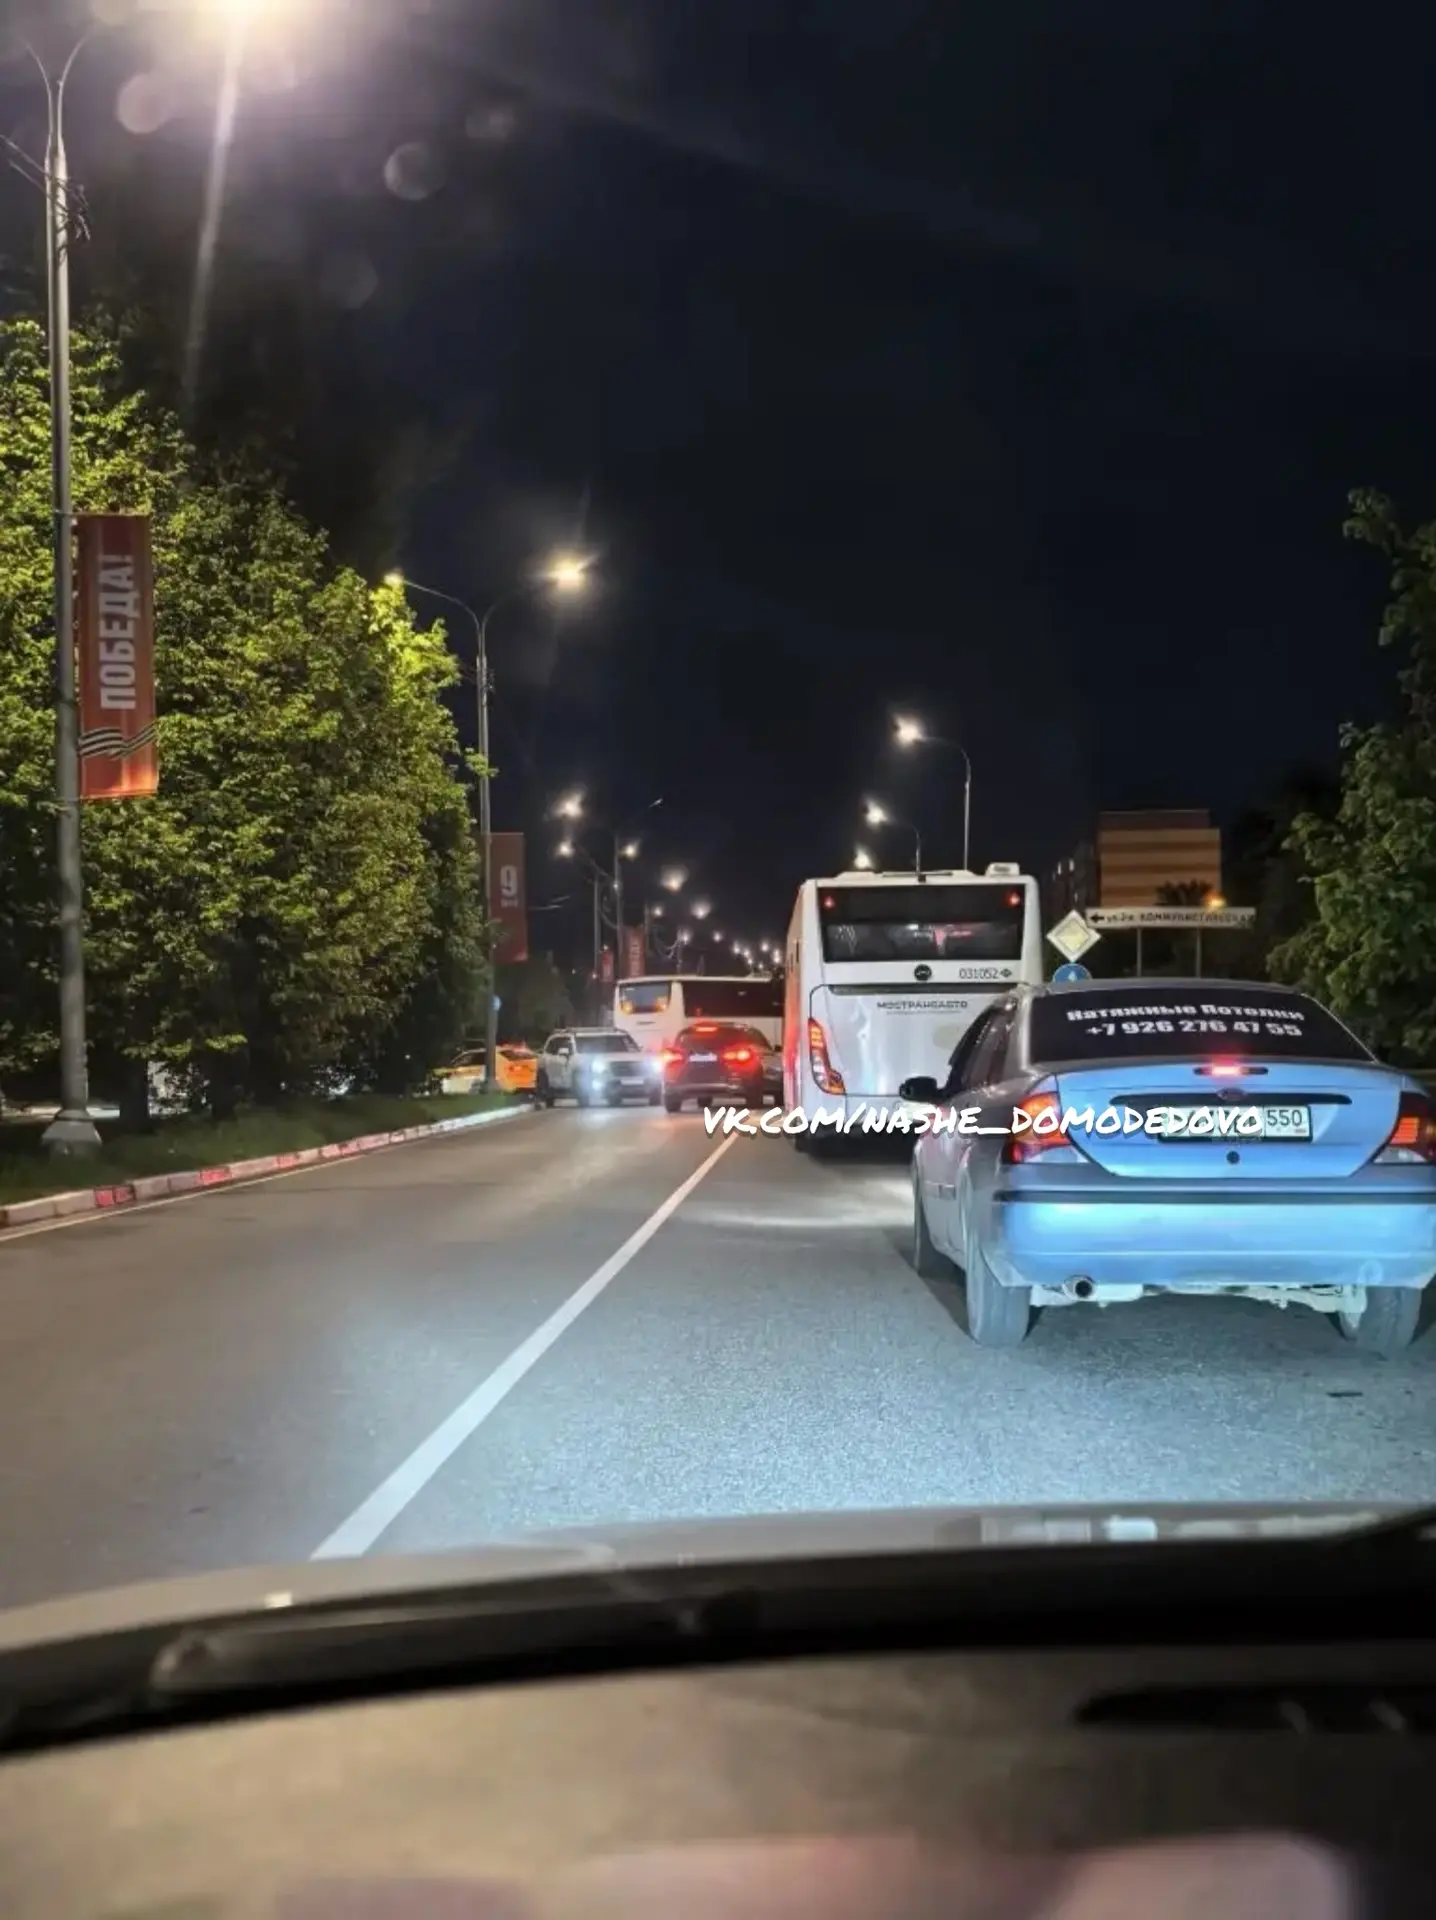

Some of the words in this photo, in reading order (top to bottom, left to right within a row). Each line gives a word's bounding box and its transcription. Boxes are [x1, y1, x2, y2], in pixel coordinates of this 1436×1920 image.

[98, 554, 140, 710] ПОБЕДА!
[500, 865, 518, 897] 9
[1066, 1005, 1197, 1021] Натяжные
[1200, 1004, 1304, 1021] Потолки
[1087, 1023, 1115, 1036] +7
[1121, 1020, 1174, 1034] 926
[1267, 1109, 1303, 1126] 550
